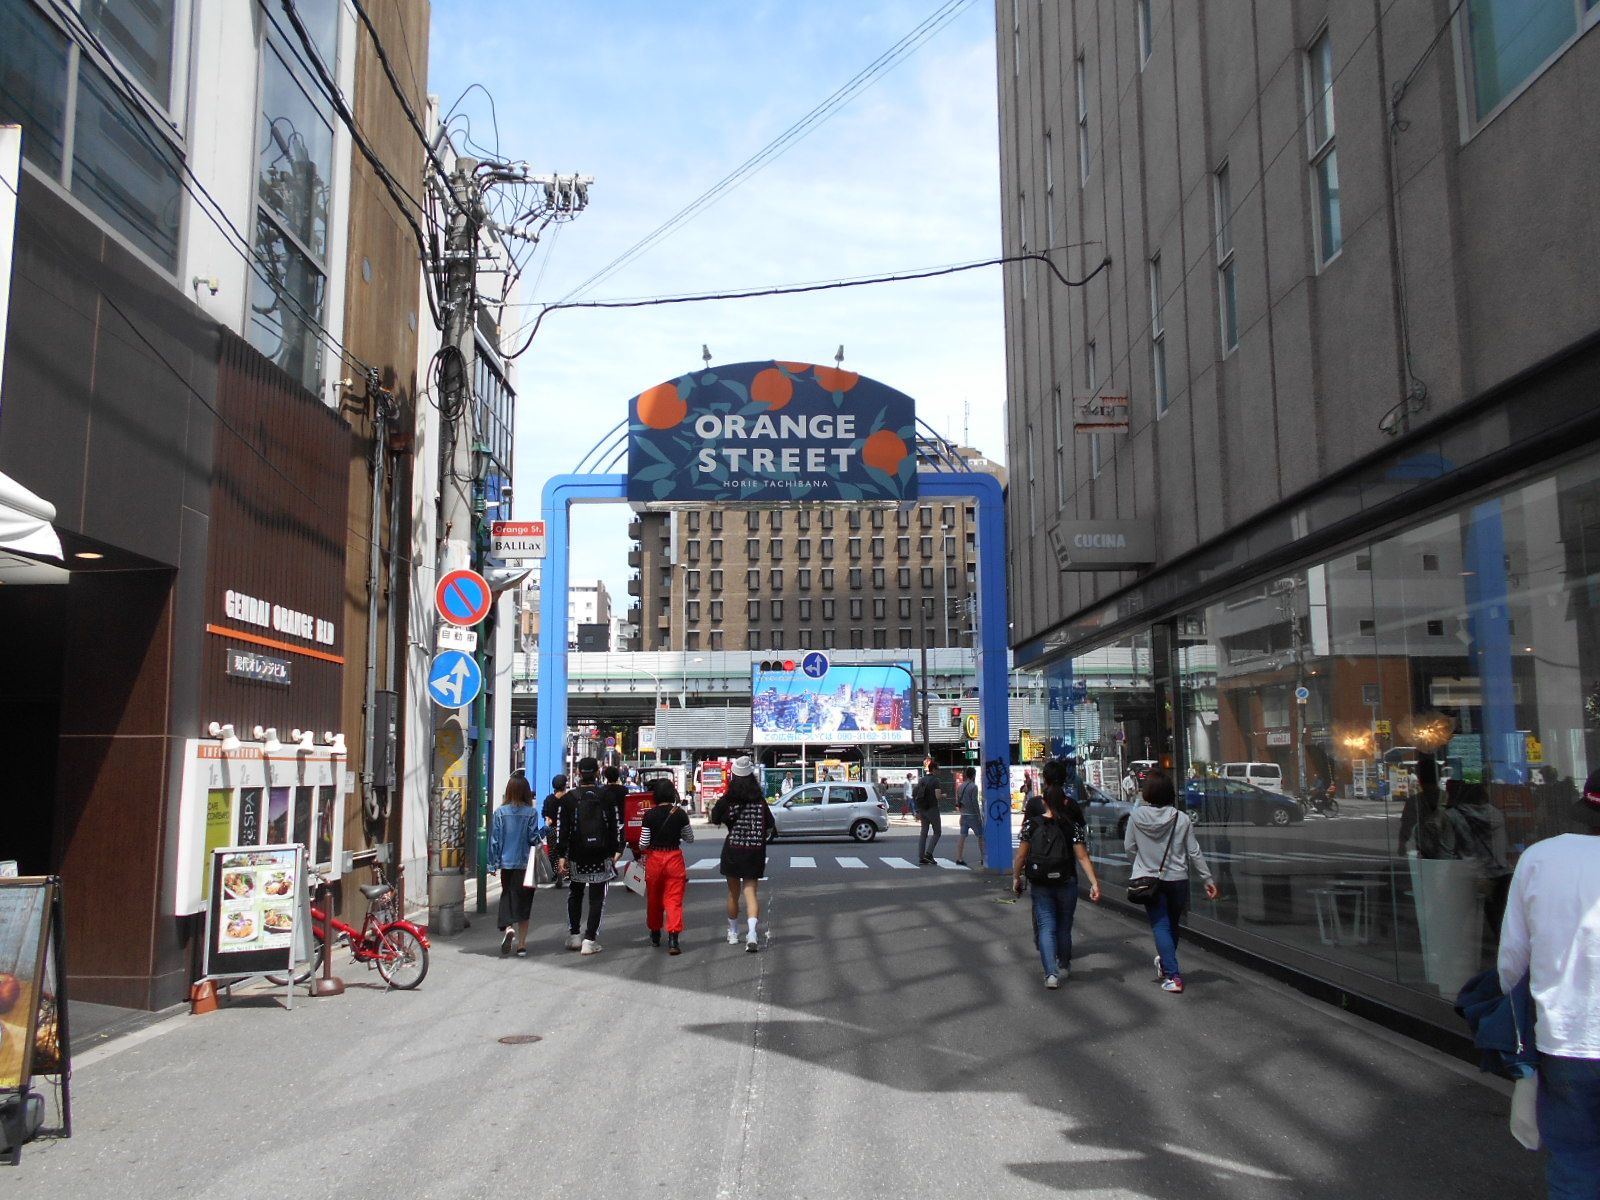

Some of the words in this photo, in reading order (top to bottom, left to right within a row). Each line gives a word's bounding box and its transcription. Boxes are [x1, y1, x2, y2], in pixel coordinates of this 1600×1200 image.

[694, 414, 856, 439] ORANGE
[698, 448, 856, 473] STREET
[723, 480, 758, 488] HORIE
[763, 480, 829, 488] TACHIBANA
[495, 525, 529, 536] Orange
[531, 525, 542, 534] St.
[495, 541, 541, 551] BALILax
[1074, 534, 1126, 549] CUCINA
[225, 589, 271, 628] GENDAI
[273, 604, 315, 640] ORANGE
[442, 630, 475, 642] 自動車
[234, 655, 287, 678] 現代オレンジビル
